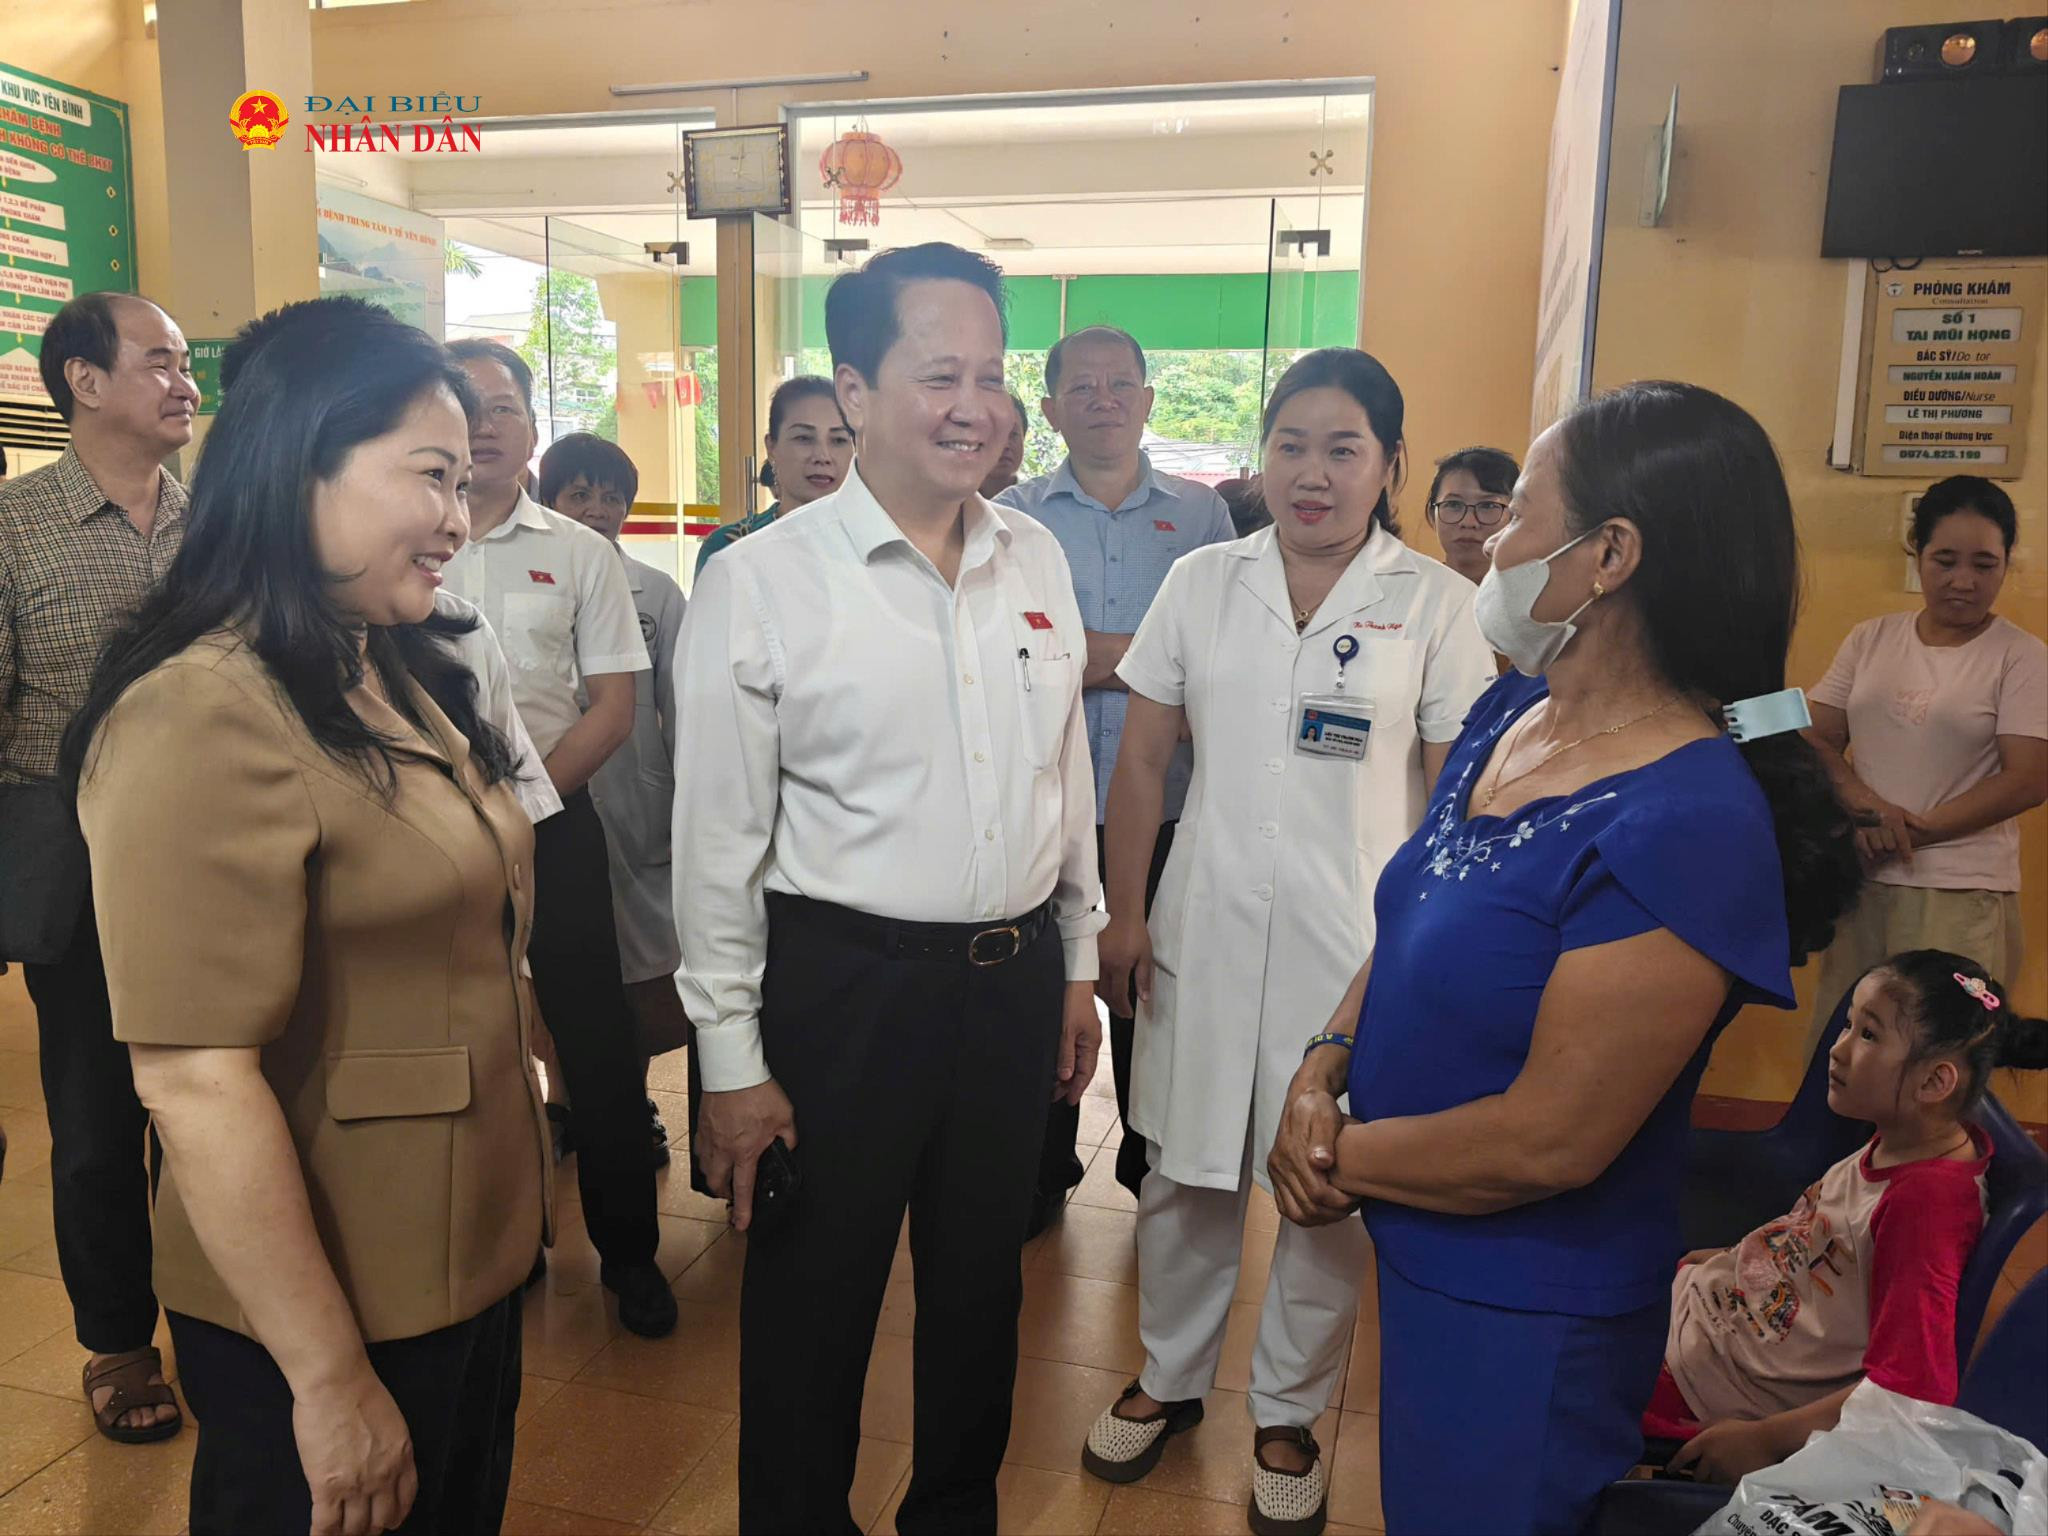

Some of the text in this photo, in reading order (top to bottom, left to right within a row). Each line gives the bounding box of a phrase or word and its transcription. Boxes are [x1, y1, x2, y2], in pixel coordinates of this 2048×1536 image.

[1, 80, 83, 119] KHU VỰC YÊN BÌNH
[32, 116, 62, 138] BỆNH
[346, 215, 370, 229] TRUNG
[371, 221, 387, 234] TÂM
[1913, 280, 2011, 296] PHÒNG KHÁM
[1942, 310, 1976, 324] SỐ 1
[1906, 328, 2011, 342] TAI MŨI HỌNG
[1916, 348, 1936, 361] BÁC
[1903, 370, 1942, 381] NGUYỄN
[1944, 370, 1972, 380] XUÂN
[1904, 388, 1926, 401] ĐIỀU
[1908, 408, 1983, 421] LÊ THỊ PHƯƠNG
